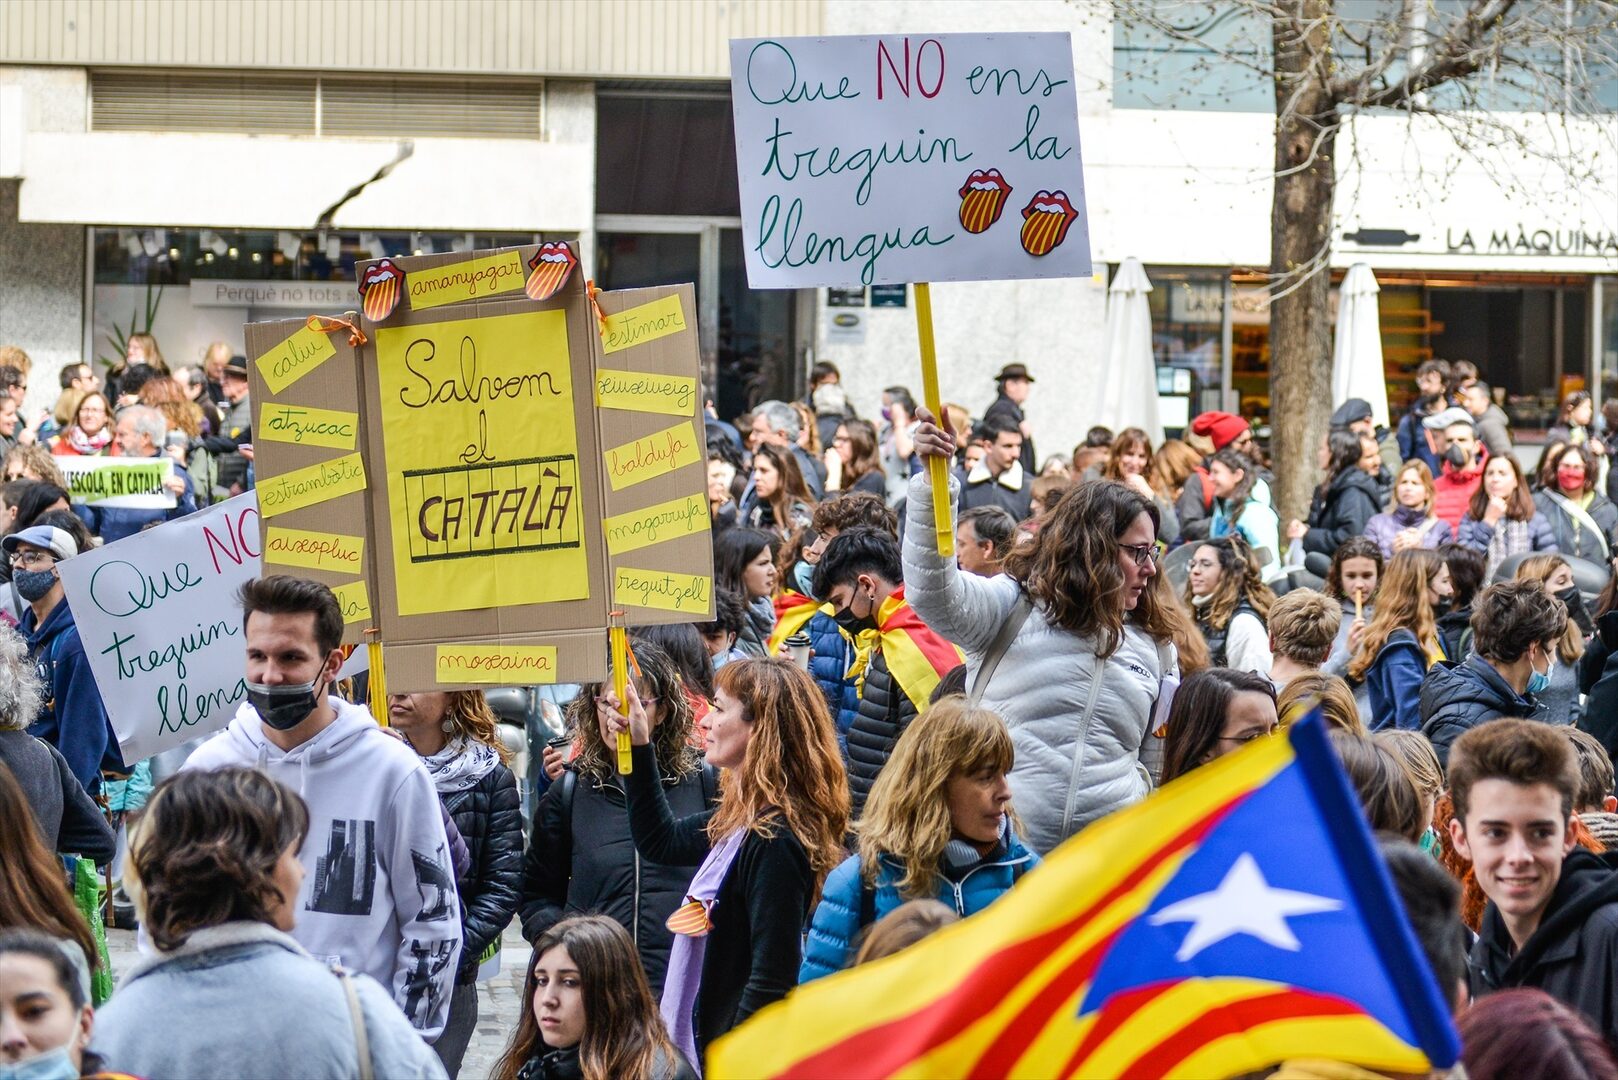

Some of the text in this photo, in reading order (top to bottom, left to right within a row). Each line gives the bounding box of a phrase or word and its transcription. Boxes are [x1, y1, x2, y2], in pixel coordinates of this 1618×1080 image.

[747, 37, 1068, 105] Que NO ens
[761, 104, 1072, 206] treguin la
[754, 194, 955, 286] llengua
[1445, 227, 1476, 250] LA
[216, 283, 276, 304] Perquè
[282, 289, 303, 301] no
[309, 285, 341, 301] tots
[411, 261, 522, 296] amanyagar
[605, 312, 683, 348] estimar
[272, 339, 323, 379] caliu
[400, 335, 562, 409] Salvem
[268, 408, 353, 442] atzucac
[459, 409, 496, 464] el
[611, 431, 689, 477] baldufa
[111, 472, 123, 494] EN
[127, 465, 164, 495] CATALÀ
[260, 459, 363, 509] estrambòtic
[418, 466, 573, 543] CATALÀ
[608, 497, 707, 542] magarrufa
[268, 536, 360, 565] aixopluc
[90, 560, 202, 617] Que
[617, 575, 708, 609] reguitzell
[101, 620, 238, 681] treguin
